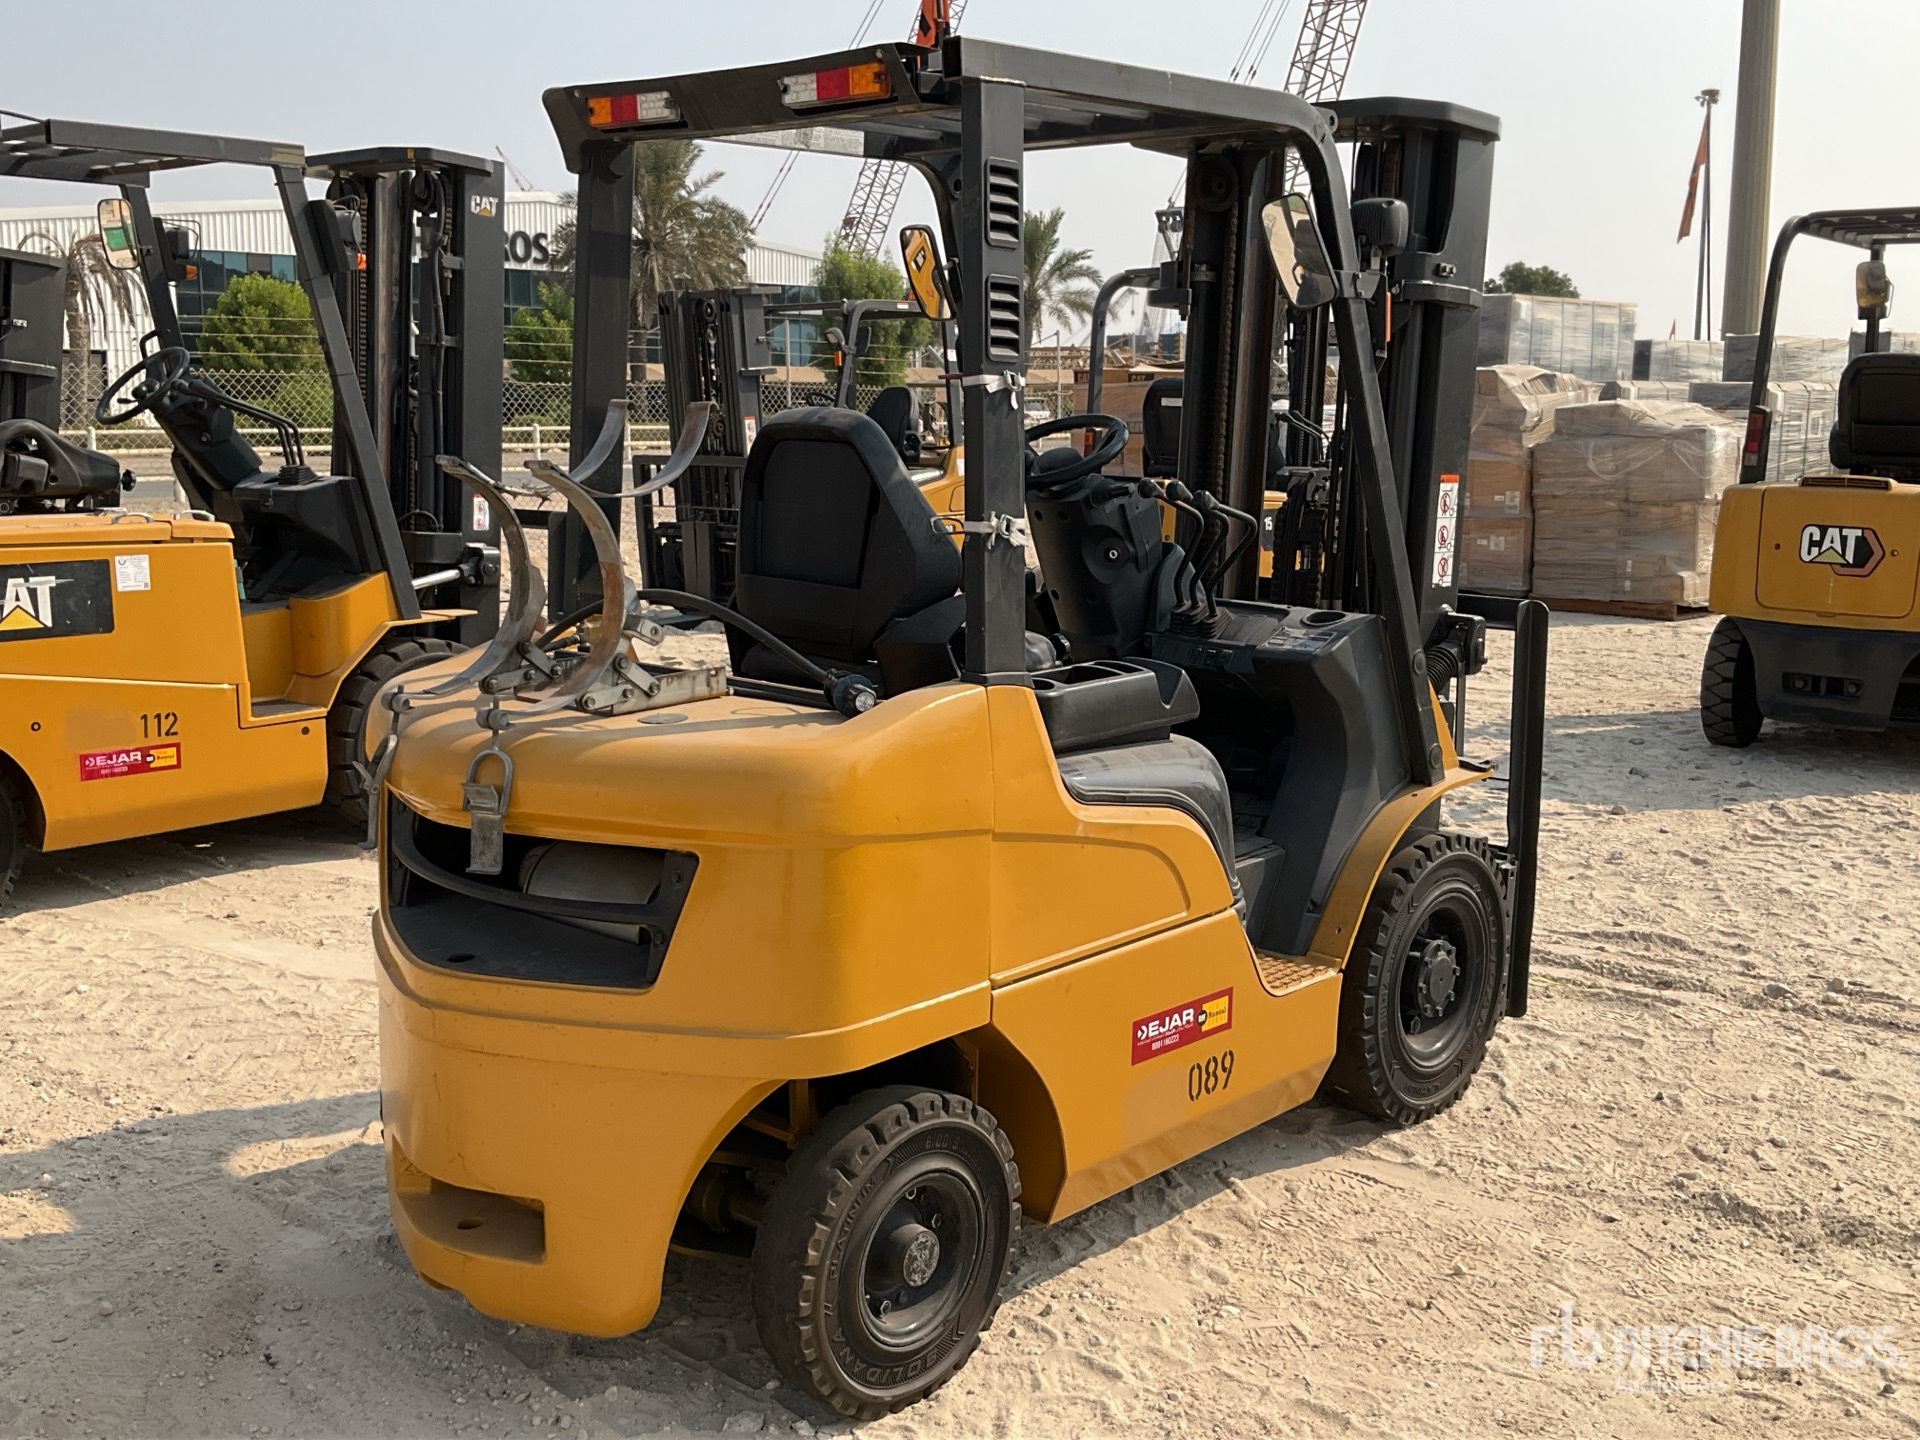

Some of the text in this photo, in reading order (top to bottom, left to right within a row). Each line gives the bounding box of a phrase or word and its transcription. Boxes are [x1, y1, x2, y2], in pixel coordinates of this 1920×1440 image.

[471, 194, 499, 217] CAT
[1800, 525, 1863, 565] CAT
[0, 575, 56, 628] AT
[140, 711, 178, 738] 112
[1148, 1008, 1194, 1038] EJAR
[1208, 1006, 1227, 1019] Rental
[1188, 1049, 1235, 1102] 089
